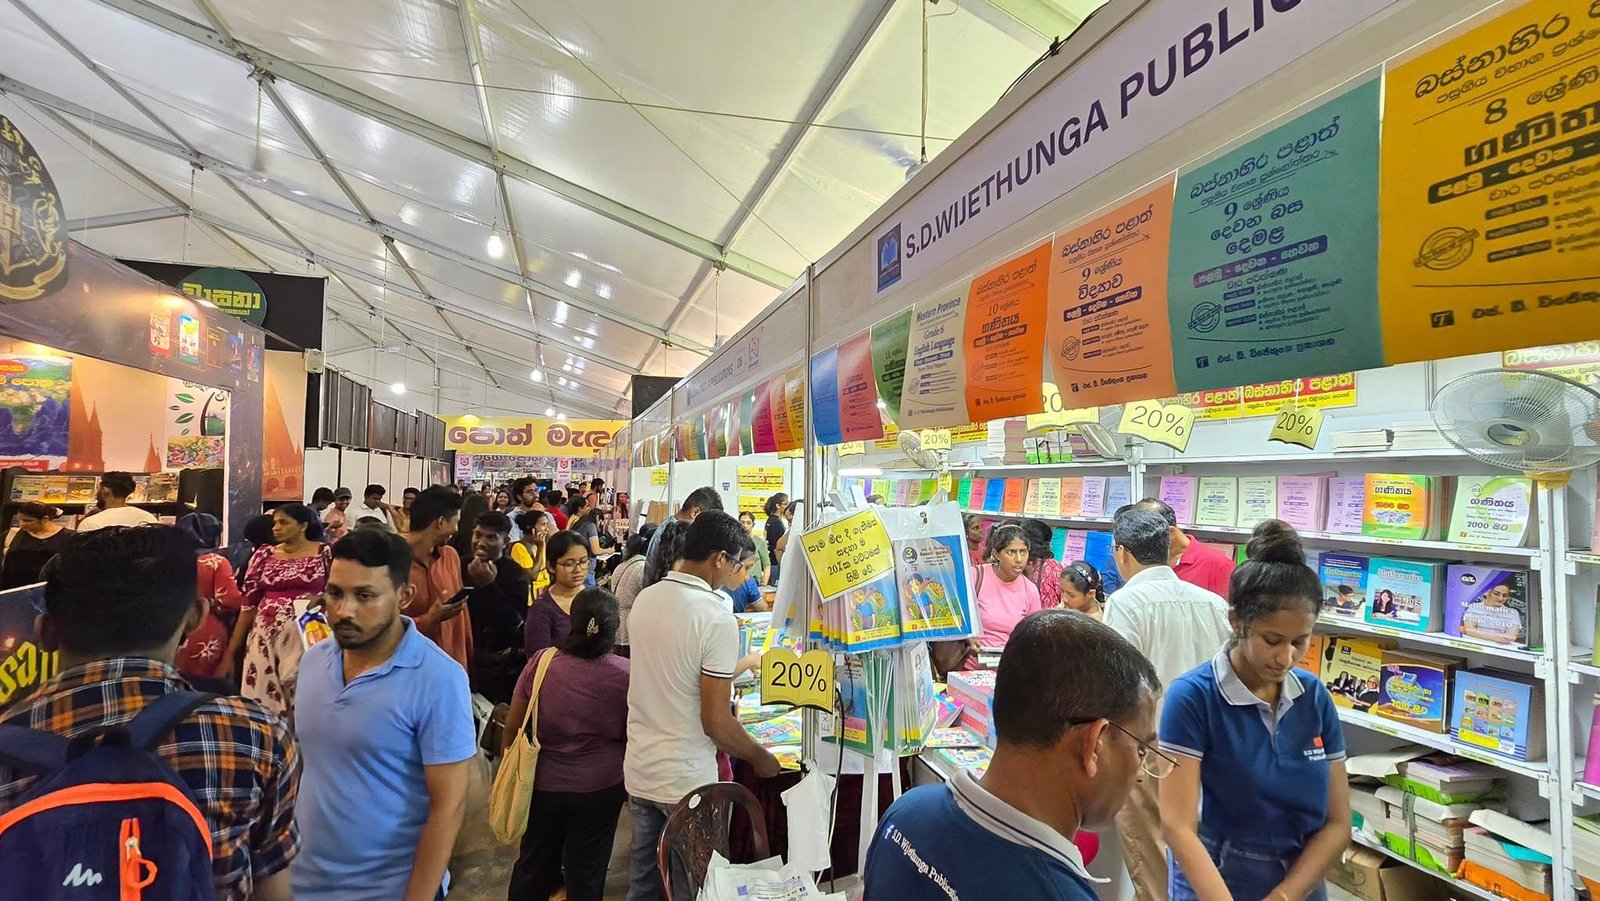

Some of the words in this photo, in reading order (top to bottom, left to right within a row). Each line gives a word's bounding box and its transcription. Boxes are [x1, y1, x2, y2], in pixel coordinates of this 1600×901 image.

[1415, 12, 1570, 98] බස්නාහිර
[1484, 98, 1508, 124] 8
[1526, 64, 1600, 105] ශ්‍රේණි
[1464, 100, 1600, 167] ගණිත
[1190, 152, 1269, 199] බස්නාහිර
[1277, 115, 1341, 160] පළාත්
[906, 99, 1109, 259] S.D.WIJETHUNGA
[1224, 202, 1238, 222] 9
[1243, 186, 1290, 210] ශ්‍රේණිය
[1061, 226, 1112, 258] බස්නාහිර
[1115, 203, 1154, 234] පළාත්
[1210, 214, 1262, 241] දෙවන
[1270, 200, 1304, 220] බස
[1226, 226, 1285, 255] දෙමළ
[1081, 267, 1091, 282] 9
[917, 308, 937, 322] Western
[937, 297, 961, 314] Province
[987, 303, 998, 316] 10
[924, 326, 940, 340] Grade
[914, 341, 930, 357] English
[930, 337, 955, 351] Language
[1244, 379, 1304, 399] බස්නාහිර
[1309, 372, 1353, 391] පළාත්
[1131, 405, 1184, 437] 20%
[1277, 411, 1314, 436] 20%
[448, 423, 533, 446] පොත්
[924, 433, 949, 444] 20%
[1375, 485, 1412, 495] ගණිතය
[1470, 497, 1515, 508] ගණිතය
[1467, 521, 1489, 529] 2000
[828, 533, 843, 544] මිල
[1378, 568, 1424, 580] Mathematics
[1461, 600, 1517, 614] Mathematics
[1463, 615, 1486, 624] From
[1489, 620, 1513, 628] 2010
[770, 661, 827, 692] 20%
[900, 836, 929, 873] Wijethunga
